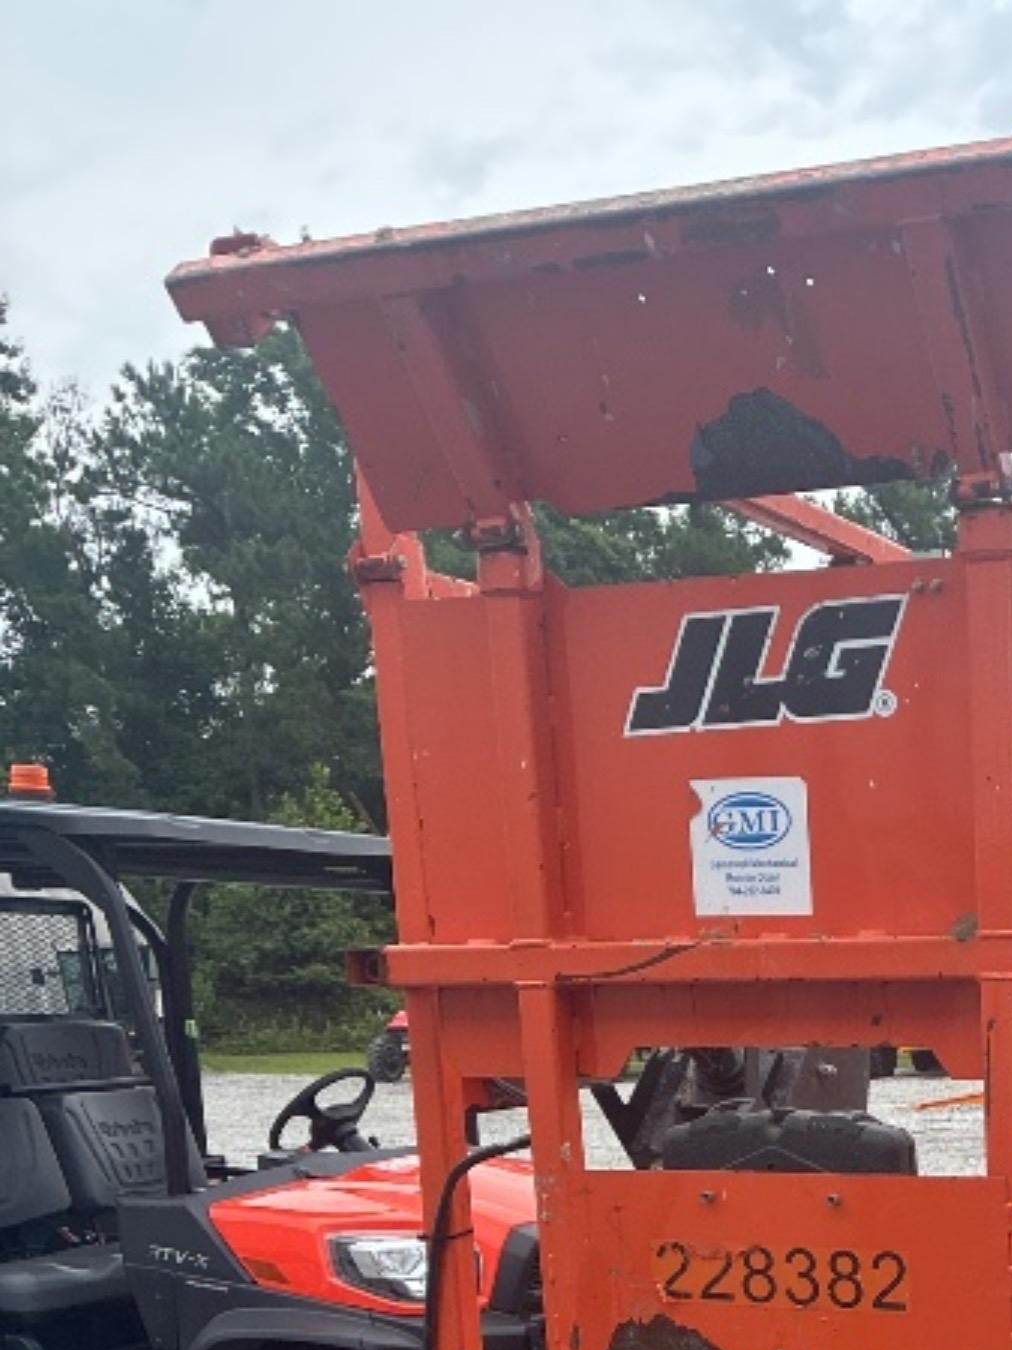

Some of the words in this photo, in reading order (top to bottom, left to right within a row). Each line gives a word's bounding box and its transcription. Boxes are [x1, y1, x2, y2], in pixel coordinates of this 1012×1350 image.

[624, 593, 908, 737] JLG
[713, 809, 781, 835] GMI
[656, 1241, 908, 1312] 228382
